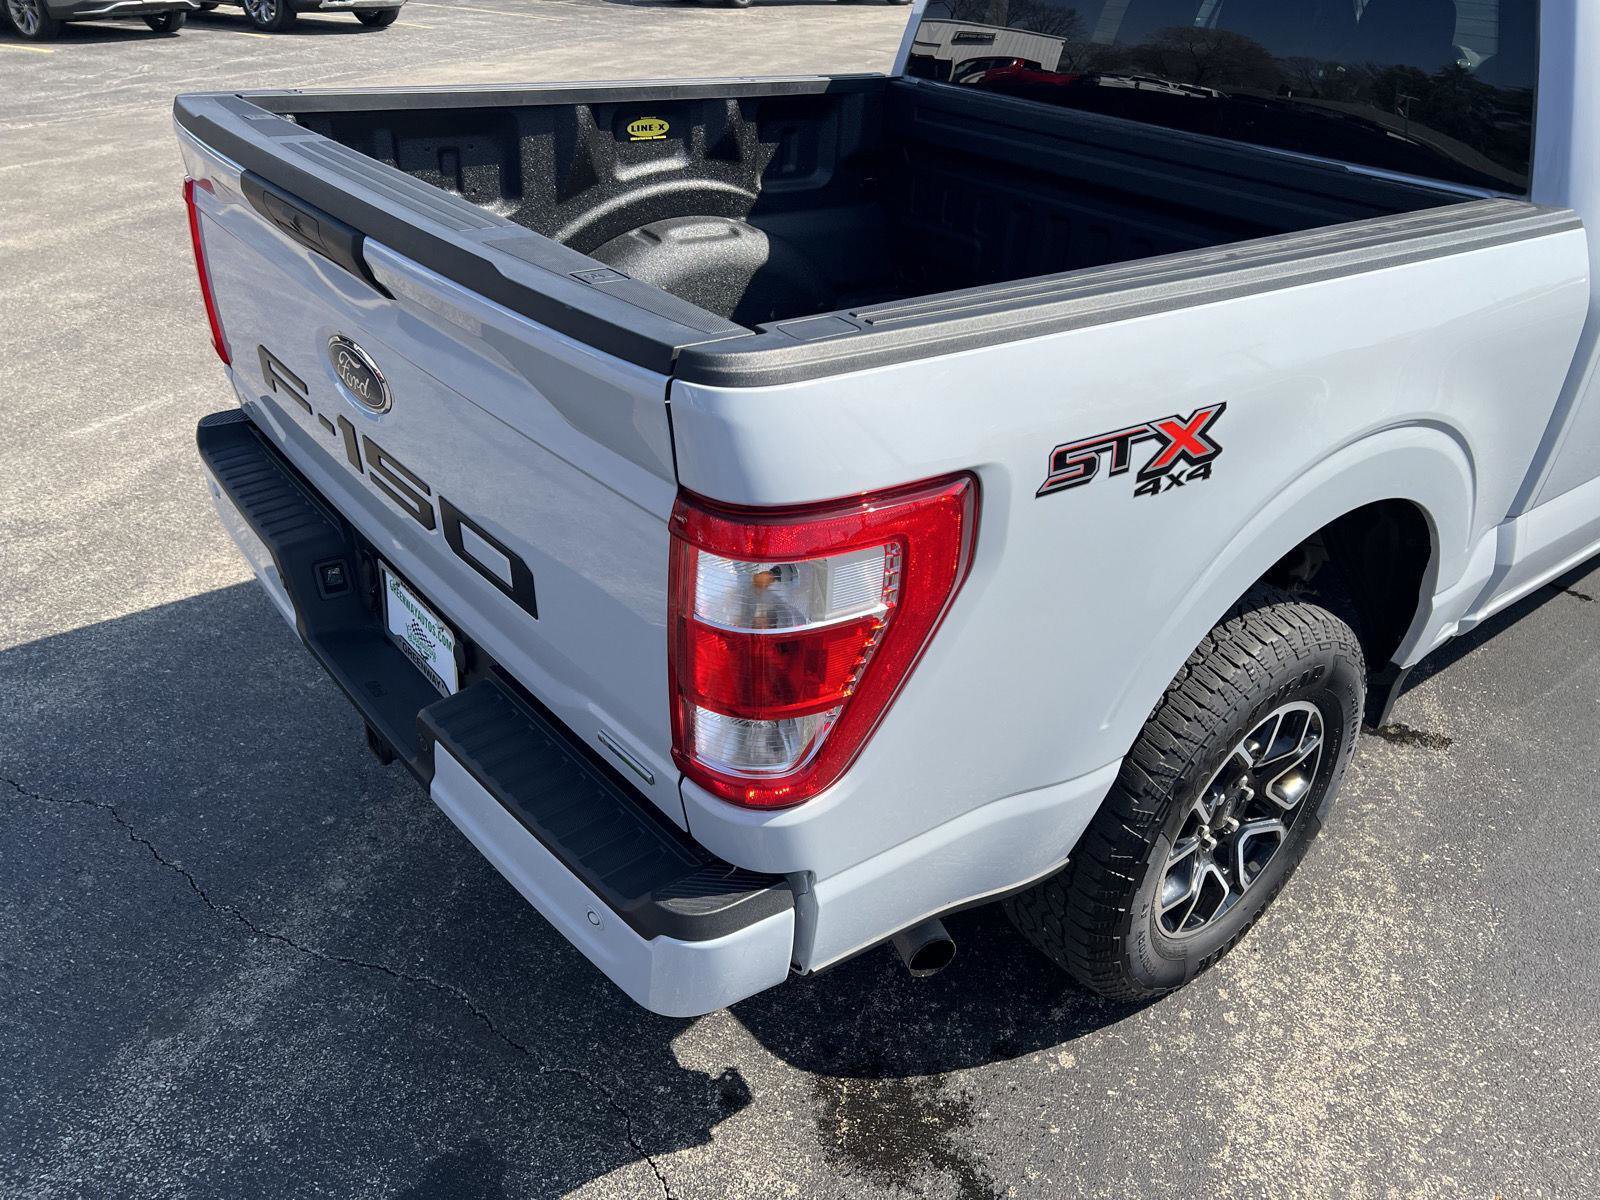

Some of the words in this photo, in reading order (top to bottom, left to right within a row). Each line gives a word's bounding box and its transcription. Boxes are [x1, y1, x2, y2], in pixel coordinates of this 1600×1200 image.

[337, 350, 372, 399] Ford
[257, 344, 539, 620] F-150
[1035, 401, 1227, 499] STX
[402, 643, 442, 688] GREENWAY
